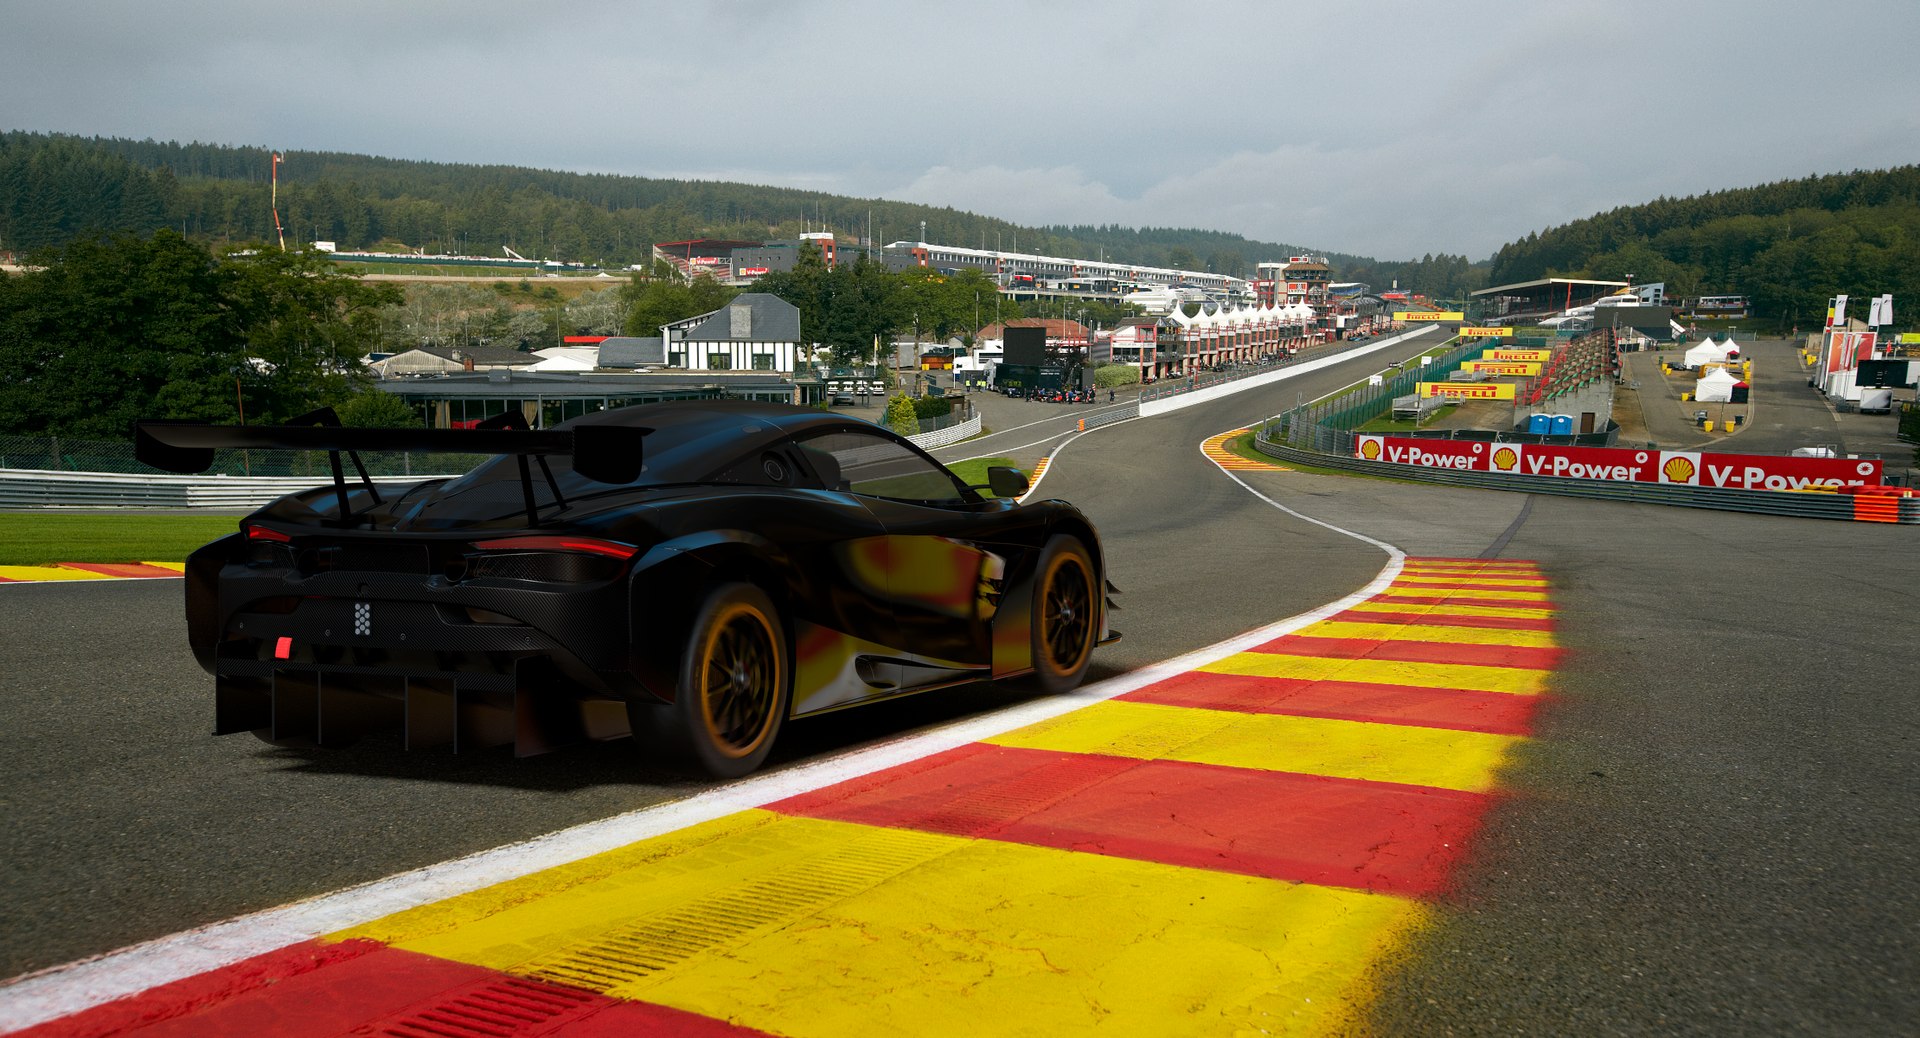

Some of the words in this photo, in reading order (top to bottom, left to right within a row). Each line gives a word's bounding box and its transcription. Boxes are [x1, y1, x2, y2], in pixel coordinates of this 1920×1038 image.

[1468, 328, 1504, 336] PIRELLI
[1494, 351, 1539, 360] PIRELLI
[1474, 363, 1528, 374] PRELLI
[1387, 445, 1478, 470] V-Power
[1526, 454, 1642, 482] V-Power
